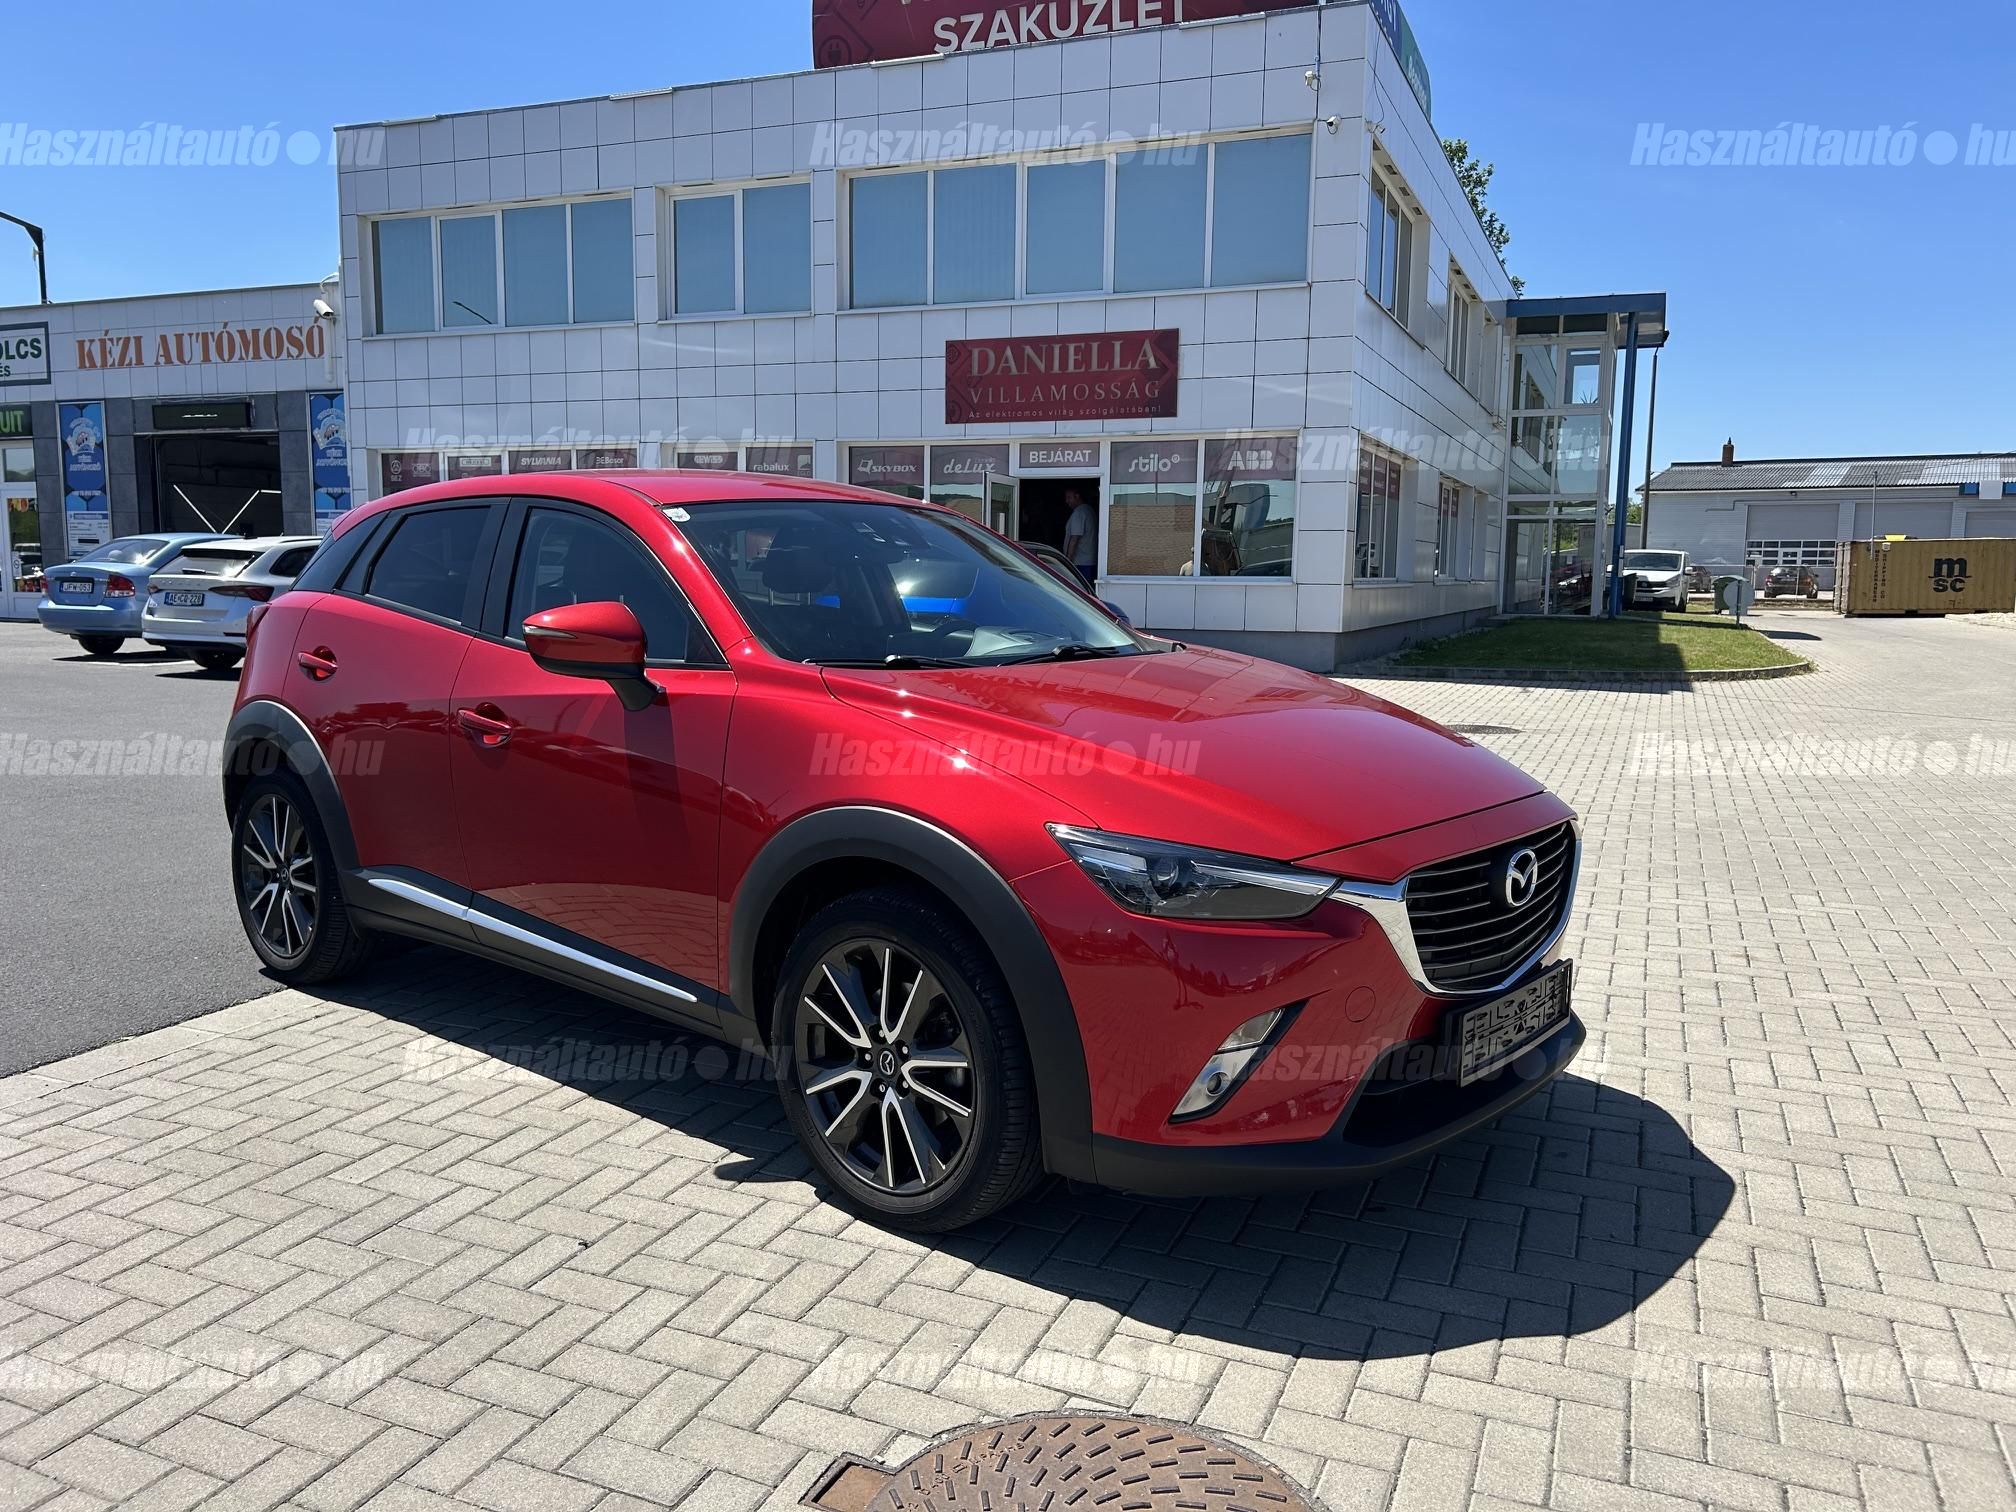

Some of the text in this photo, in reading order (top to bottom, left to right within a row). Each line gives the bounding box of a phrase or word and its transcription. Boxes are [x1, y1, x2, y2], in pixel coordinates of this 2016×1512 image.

[0, 337, 42, 360] LCS
[76, 314, 325, 370] KÉZI AUTÓMOSÓ
[968, 338, 1160, 377] DANIELLA
[969, 377, 1161, 404] VILLAMOSSÁG
[1029, 447, 1092, 463] BEJÁRAT
[1128, 452, 1171, 473] stilo
[1227, 450, 1274, 471] ABB
[753, 462, 790, 472] rabalux
[871, 464, 917, 473] SKYBOX
